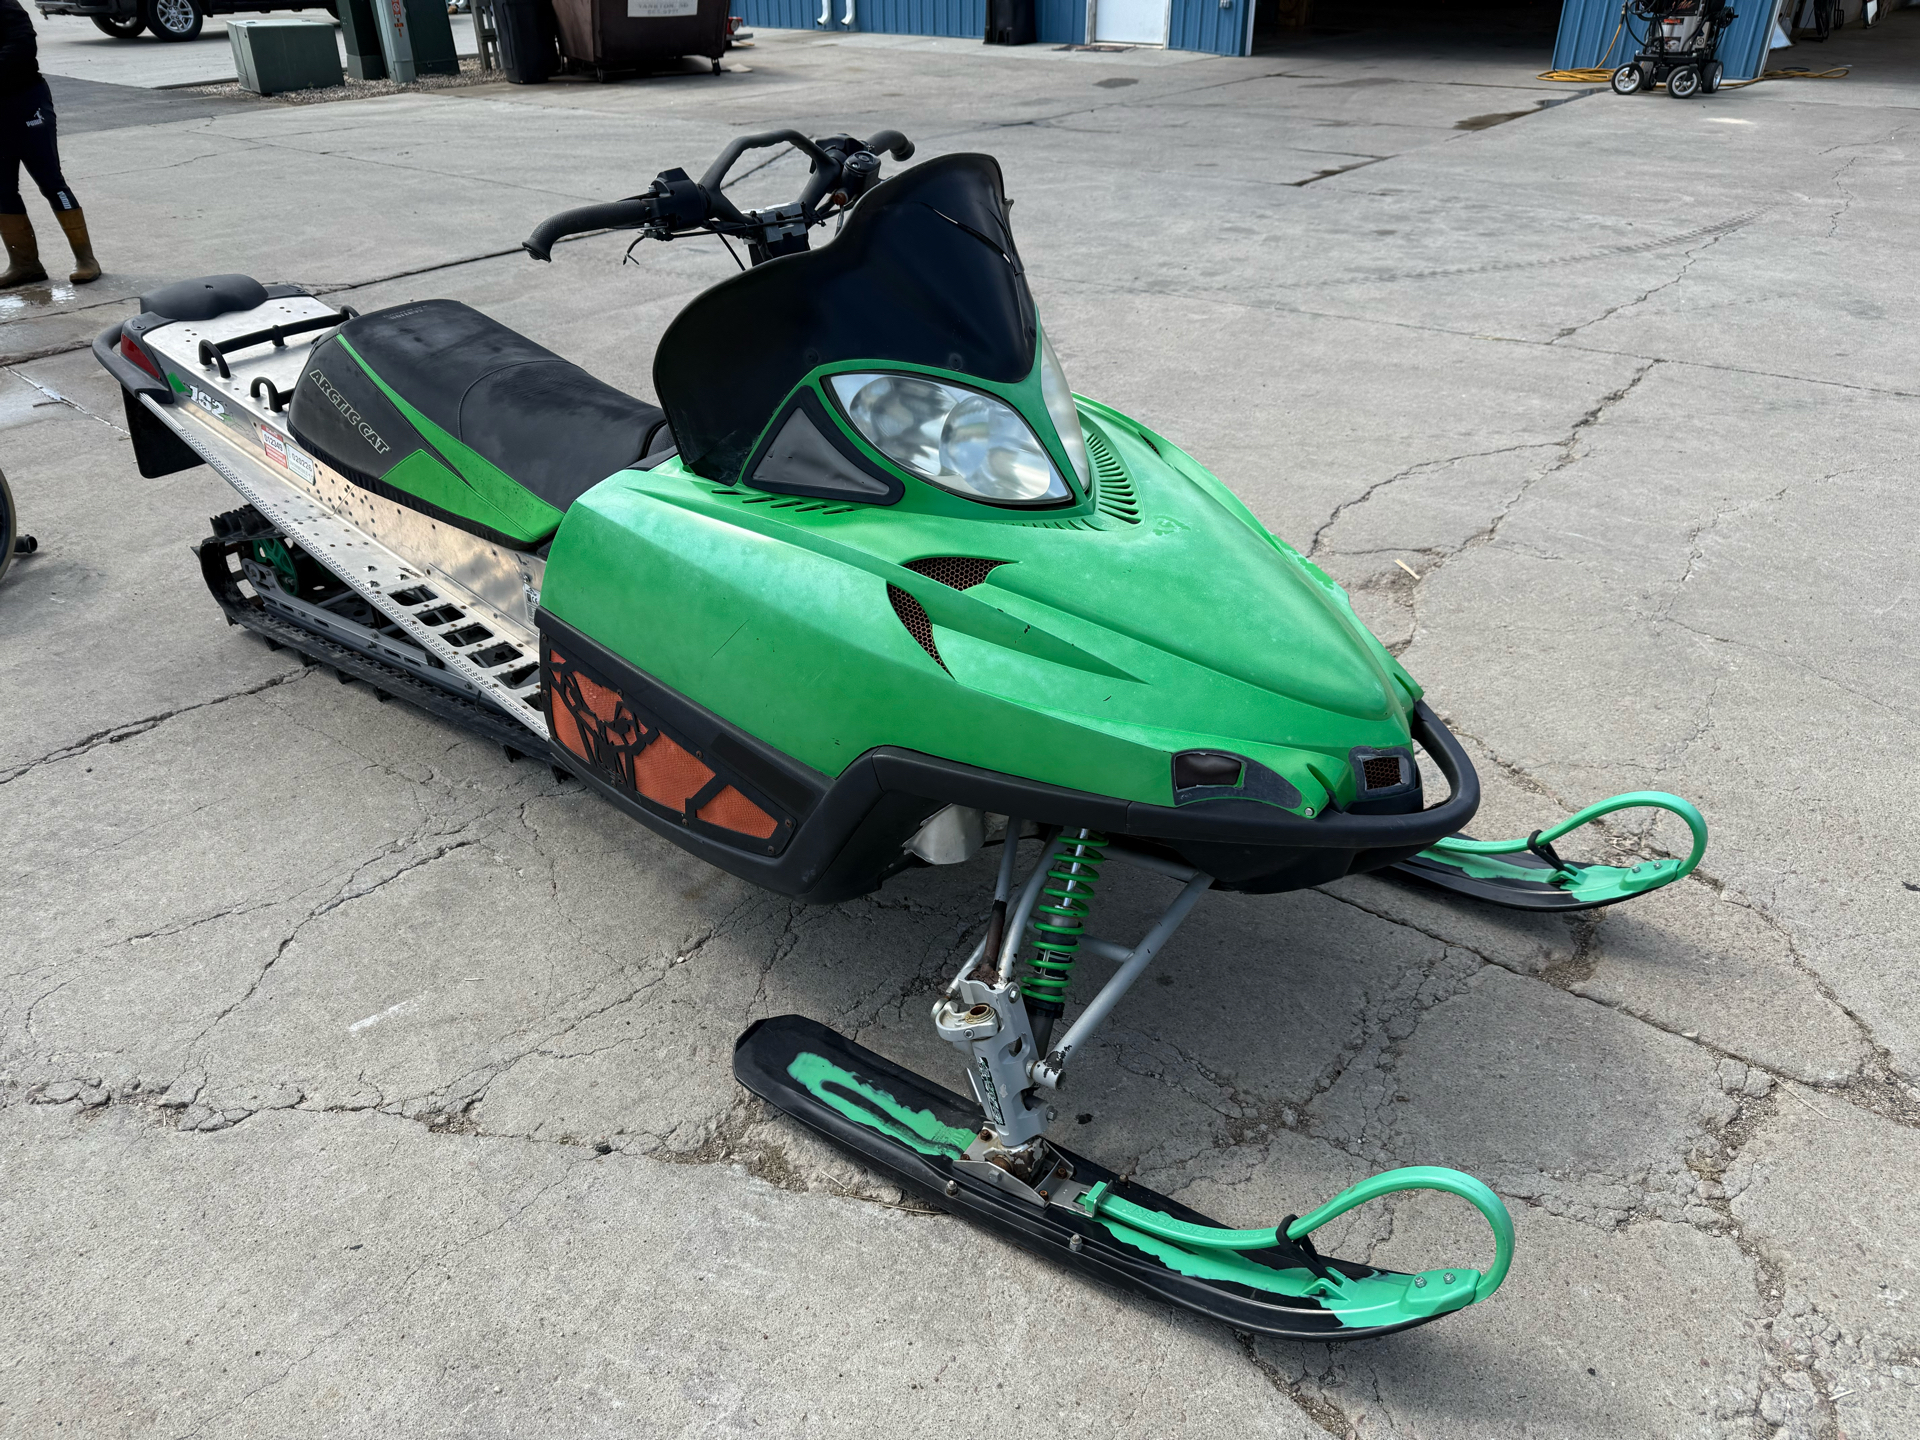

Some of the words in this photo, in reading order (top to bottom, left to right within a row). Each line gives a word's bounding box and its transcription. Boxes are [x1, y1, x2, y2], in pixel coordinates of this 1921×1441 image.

[189, 385, 225, 421] 162
[309, 369, 359, 425] ARCTIC
[358, 422, 390, 454] CAT
